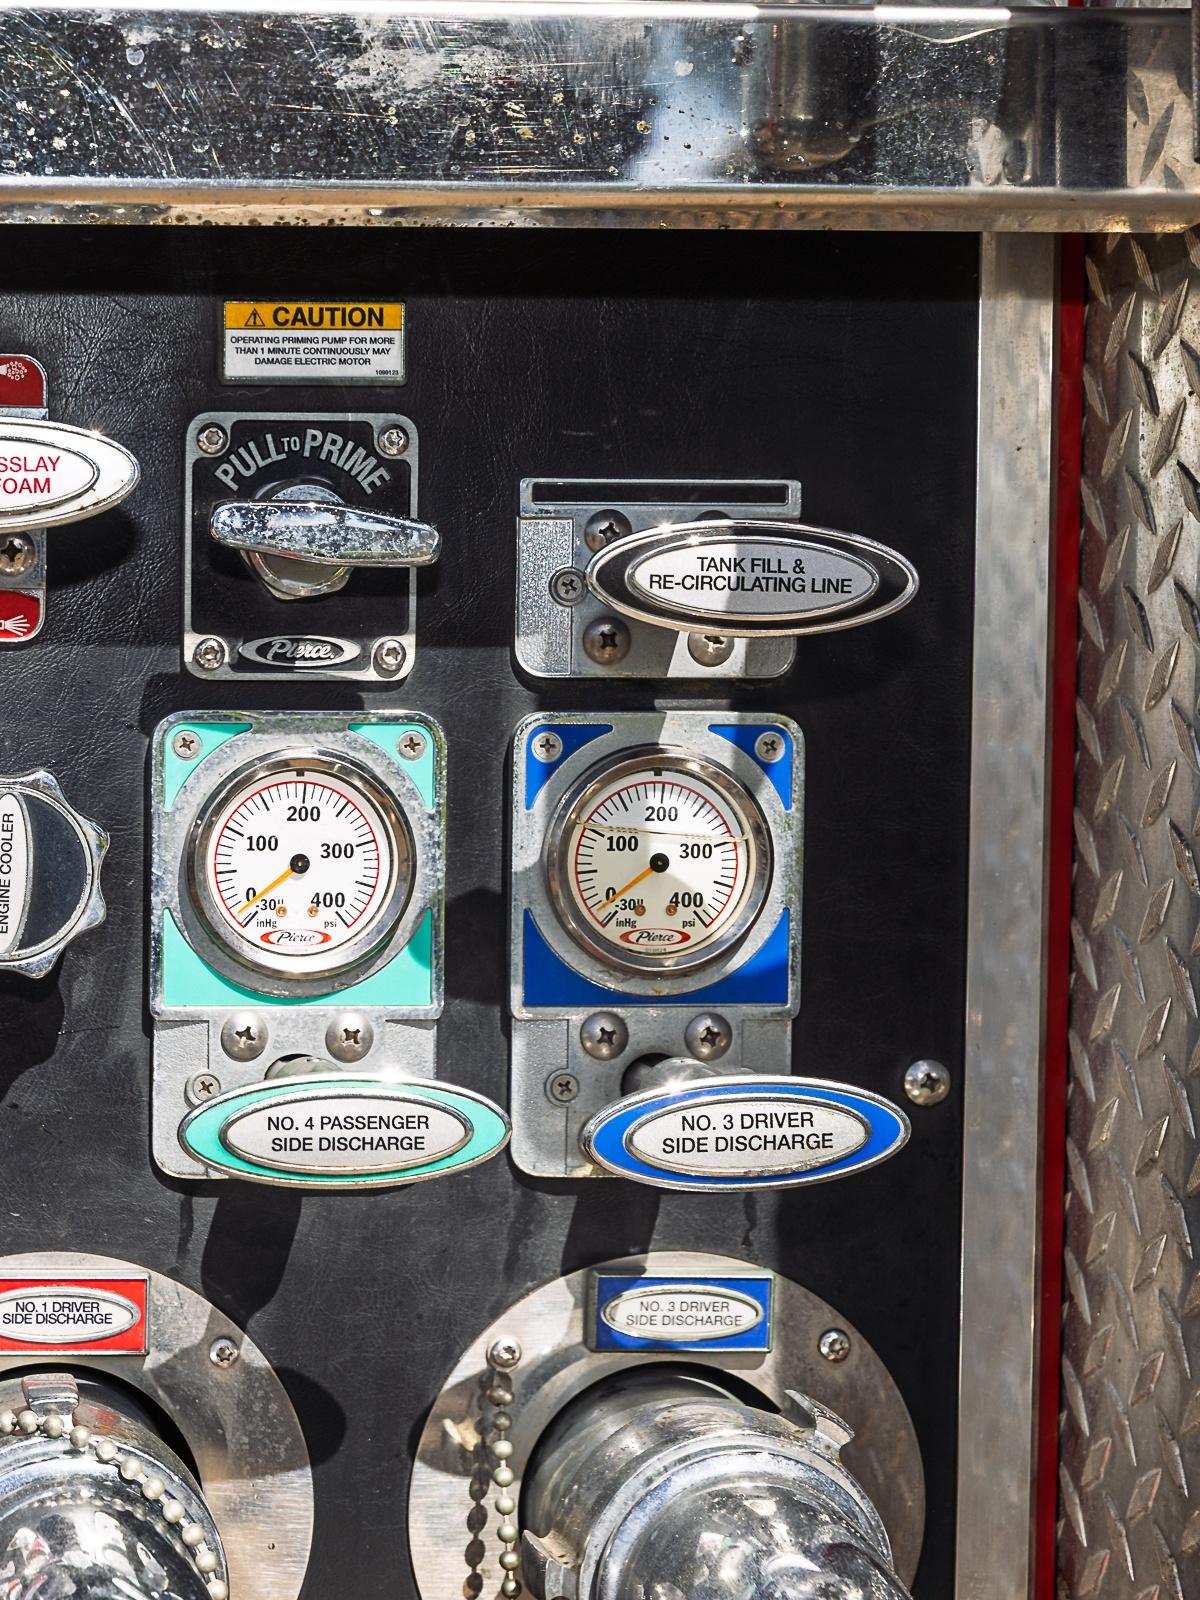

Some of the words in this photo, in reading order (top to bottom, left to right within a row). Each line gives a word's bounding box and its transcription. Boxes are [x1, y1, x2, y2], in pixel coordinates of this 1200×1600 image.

[273, 307, 384, 327] CAUTION
[230, 336, 280, 345] OPERATING
[282, 336, 319, 345] PRIMING
[322, 336, 347, 345] PUMP
[349, 336, 367, 345] FOR
[369, 336, 395, 345] MORE
[235, 347, 258, 355] THAN
[260, 347, 264, 355] 1
[267, 347, 301, 355] MINUTE
[303, 347, 370, 355] CONTINUOUSLY
[372, 347, 391, 355] MAY
[254, 357, 292, 366] DAMAGE
[294, 357, 336, 366] ELECTRIC
[339, 357, 371, 366] MOTOR
[214, 433, 287, 491] PULL
[280, 436, 300, 452] TO
[303, 429, 390, 495] PRIME
[697, 557, 746, 572] TANK
[751, 558, 788, 573] FILL
[792, 559, 805, 574] &
[650, 574, 805, 592] RE-CIRCULATING
[811, 578, 852, 593] LINE
[286, 806, 321, 822] 200
[645, 806, 678, 822] 200
[0, 813, 14, 875] COOLER
[246, 836, 278, 851] 100
[320, 843, 354, 859] 300
[606, 836, 639, 851] 100
[679, 843, 712, 859] 300
[245, 887, 256, 902] 0
[311, 892, 345, 908] 400
[669, 892, 703, 908] 400
[256, 918, 277, 929] inHg
[324, 919, 337, 928] psi
[616, 918, 637, 929] inHg
[682, 918, 696, 928] psi
[636, 930, 674, 943] Pierce
[267, 1116, 299, 1131] NO.
[304, 1116, 314, 1130] 4
[320, 1115, 430, 1130] PASSENGER
[681, 1115, 716, 1131] NO.
[723, 1114, 734, 1130] 3
[741, 1112, 814, 1129] DRIVER
[271, 1137, 313, 1152] SIDE
[318, 1136, 425, 1151] DISCHARGE
[662, 1137, 708, 1154] SIDE
[715, 1133, 834, 1152] DISCHARGE
[15, 1302, 38, 1313] NO.
[42, 1302, 47, 1312] 1
[52, 1302, 100, 1313] DRIVER
[640, 1301, 663, 1312] NO.
[668, 1301, 676, 1312] 3
[680, 1301, 730, 1312] DRIVER
[2, 1313, 32, 1325] SIDE
[36, 1313, 113, 1325] DISCHARGE
[626, 1315, 658, 1326] SIDE
[662, 1315, 743, 1326] DISCHARGE
